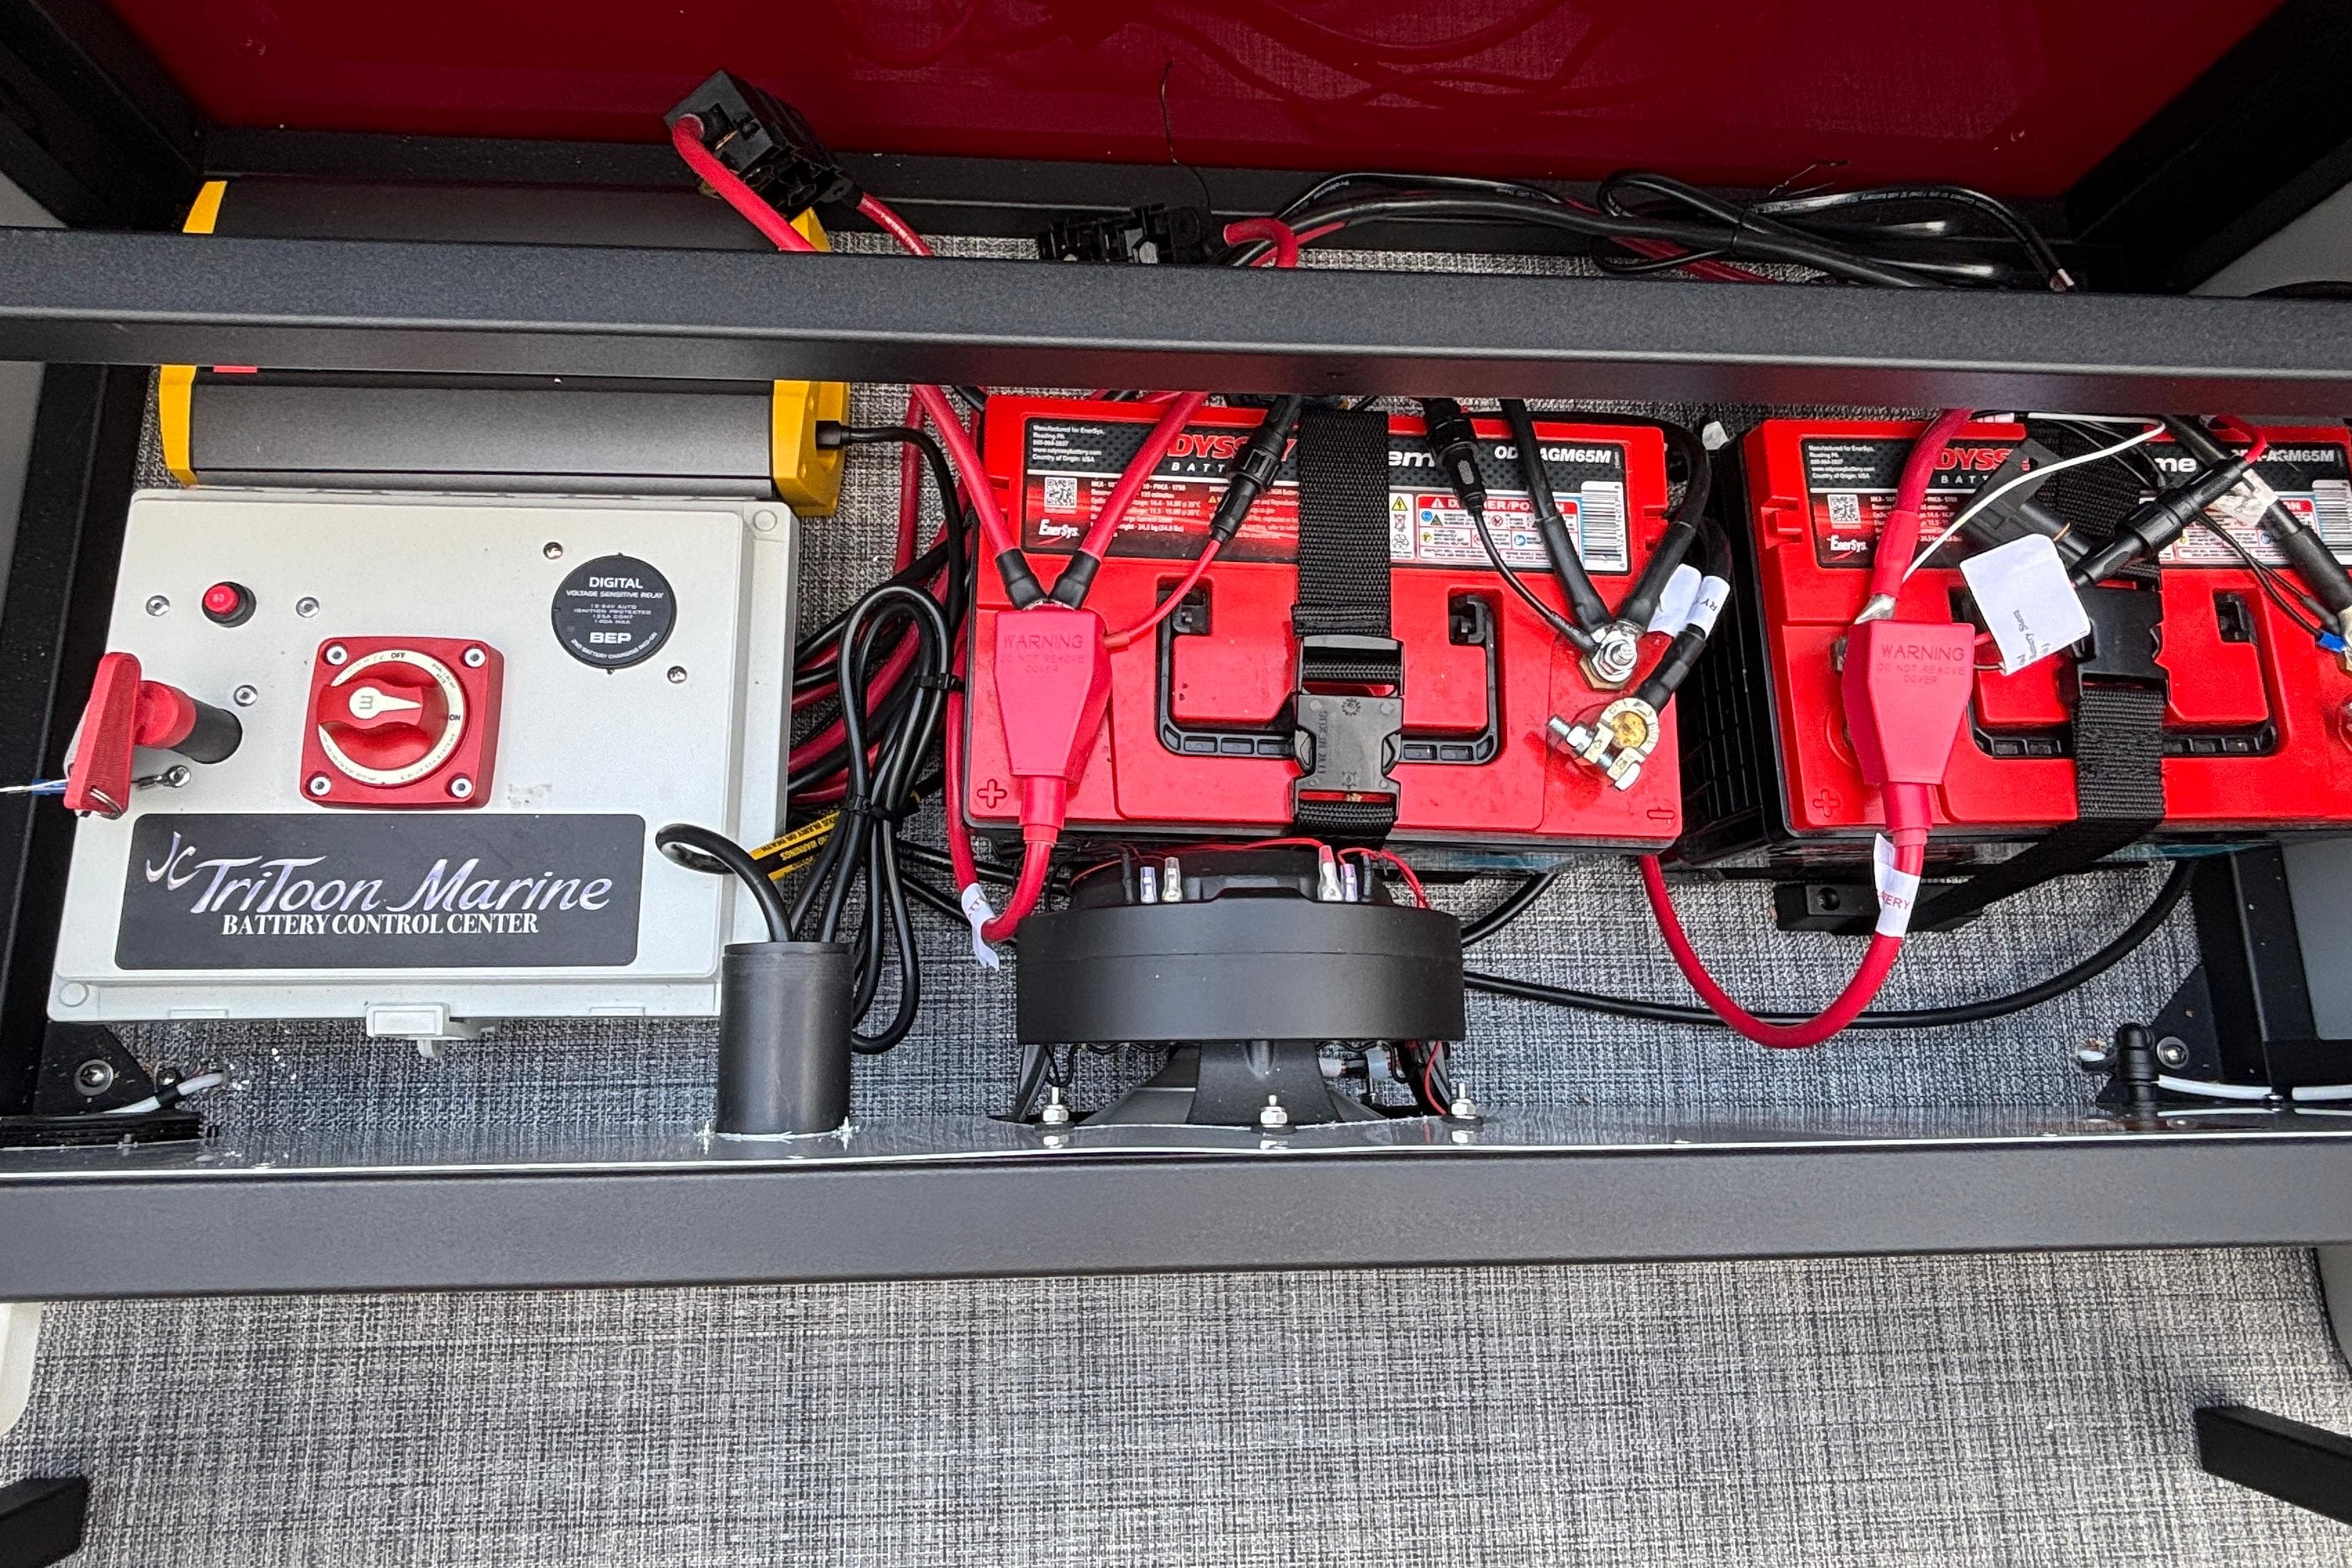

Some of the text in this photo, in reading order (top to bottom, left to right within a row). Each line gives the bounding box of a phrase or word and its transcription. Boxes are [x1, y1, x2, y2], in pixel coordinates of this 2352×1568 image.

[589, 577, 644, 589] DIGITAL
[566, 590, 598, 598] VOLTAGE
[599, 590, 639, 599] SENSITIVE
[590, 632, 632, 644] BEP
[1003, 634, 1083, 649] WARNING
[581, 646, 608, 660] BATTERY
[608, 647, 640, 660] CHARGING
[1880, 644, 1965, 662] WARNING
[1877, 663, 1966, 675] DO NOT REMOVE
[1903, 674, 1938, 684] COVER
[760, 838, 787, 852] DEATH
[779, 840, 817, 861] WARNINGS
[190, 855, 383, 914] TriToon
[385, 858, 613, 913] Marine
[221, 913, 539, 935] BATTERY CONTROL CENTER
